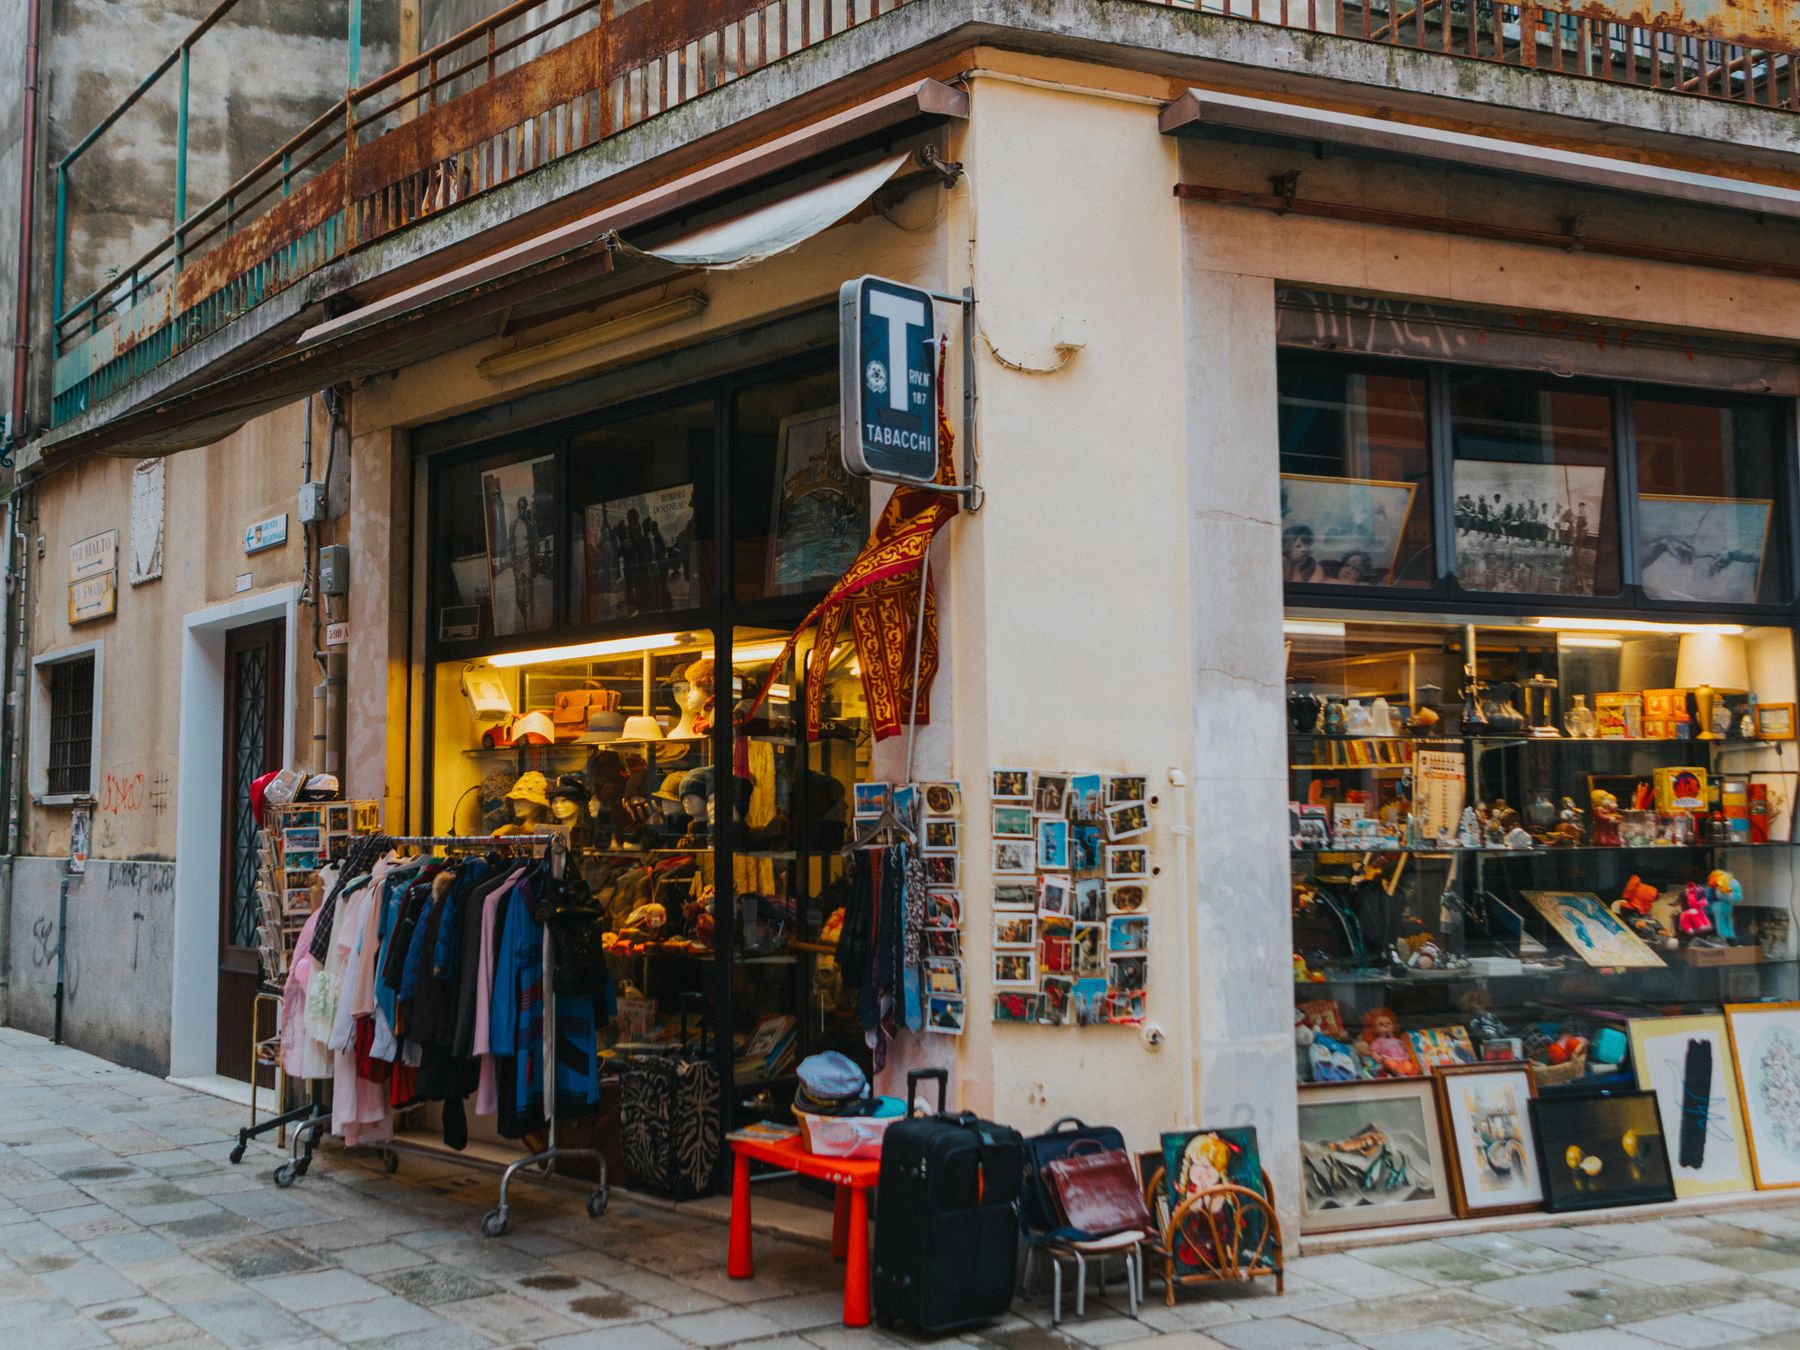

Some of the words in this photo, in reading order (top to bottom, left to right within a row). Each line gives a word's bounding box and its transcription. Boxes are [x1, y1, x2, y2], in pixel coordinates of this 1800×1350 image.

[869, 289, 925, 411] T
[913, 391, 927, 405] 187
[866, 424, 931, 452] TABACCHI
[85, 537, 112, 557] RIALTO
